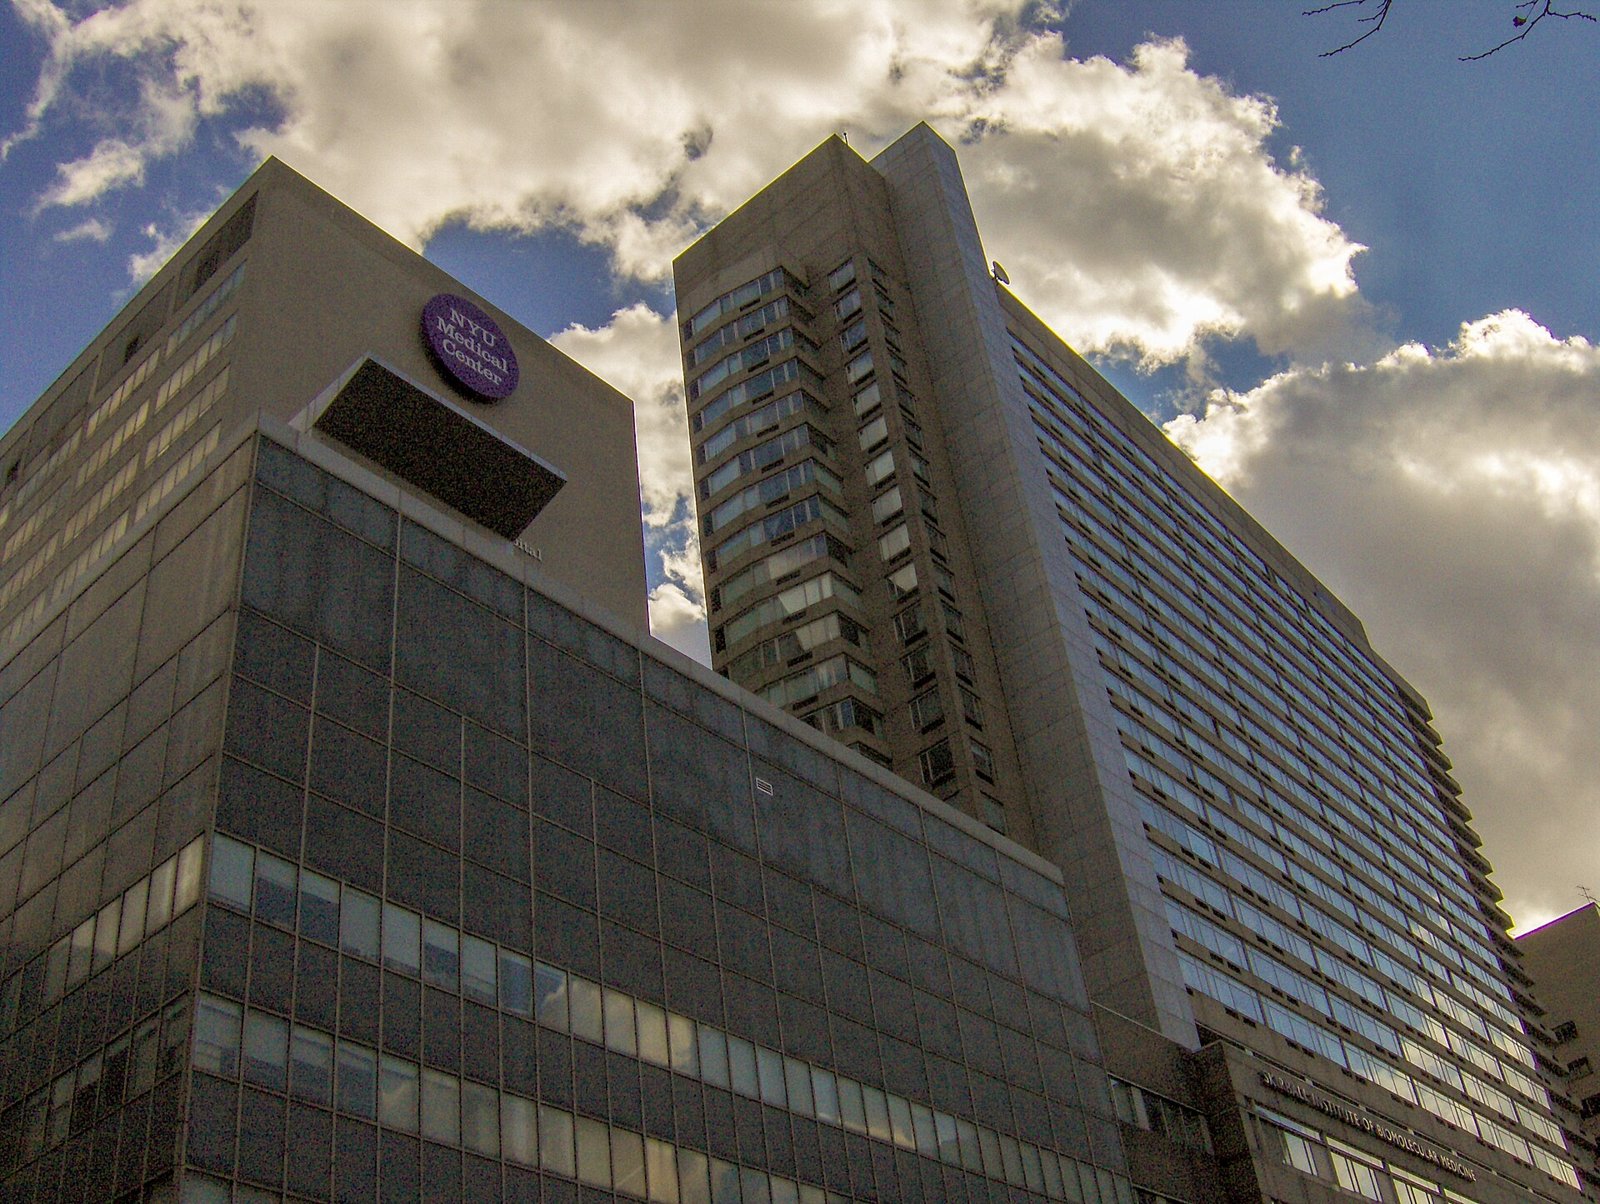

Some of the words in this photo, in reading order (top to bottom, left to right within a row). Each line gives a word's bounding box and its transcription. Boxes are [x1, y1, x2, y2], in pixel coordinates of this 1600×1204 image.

[436, 315, 509, 374] Medical
[450, 307, 497, 347] NYU
[442, 338, 503, 386] Center
[1360, 1116, 1375, 1133] OF
[1375, 1123, 1441, 1164] BIOMOLECULAR
[1439, 1154, 1477, 1182] MEDICINE
